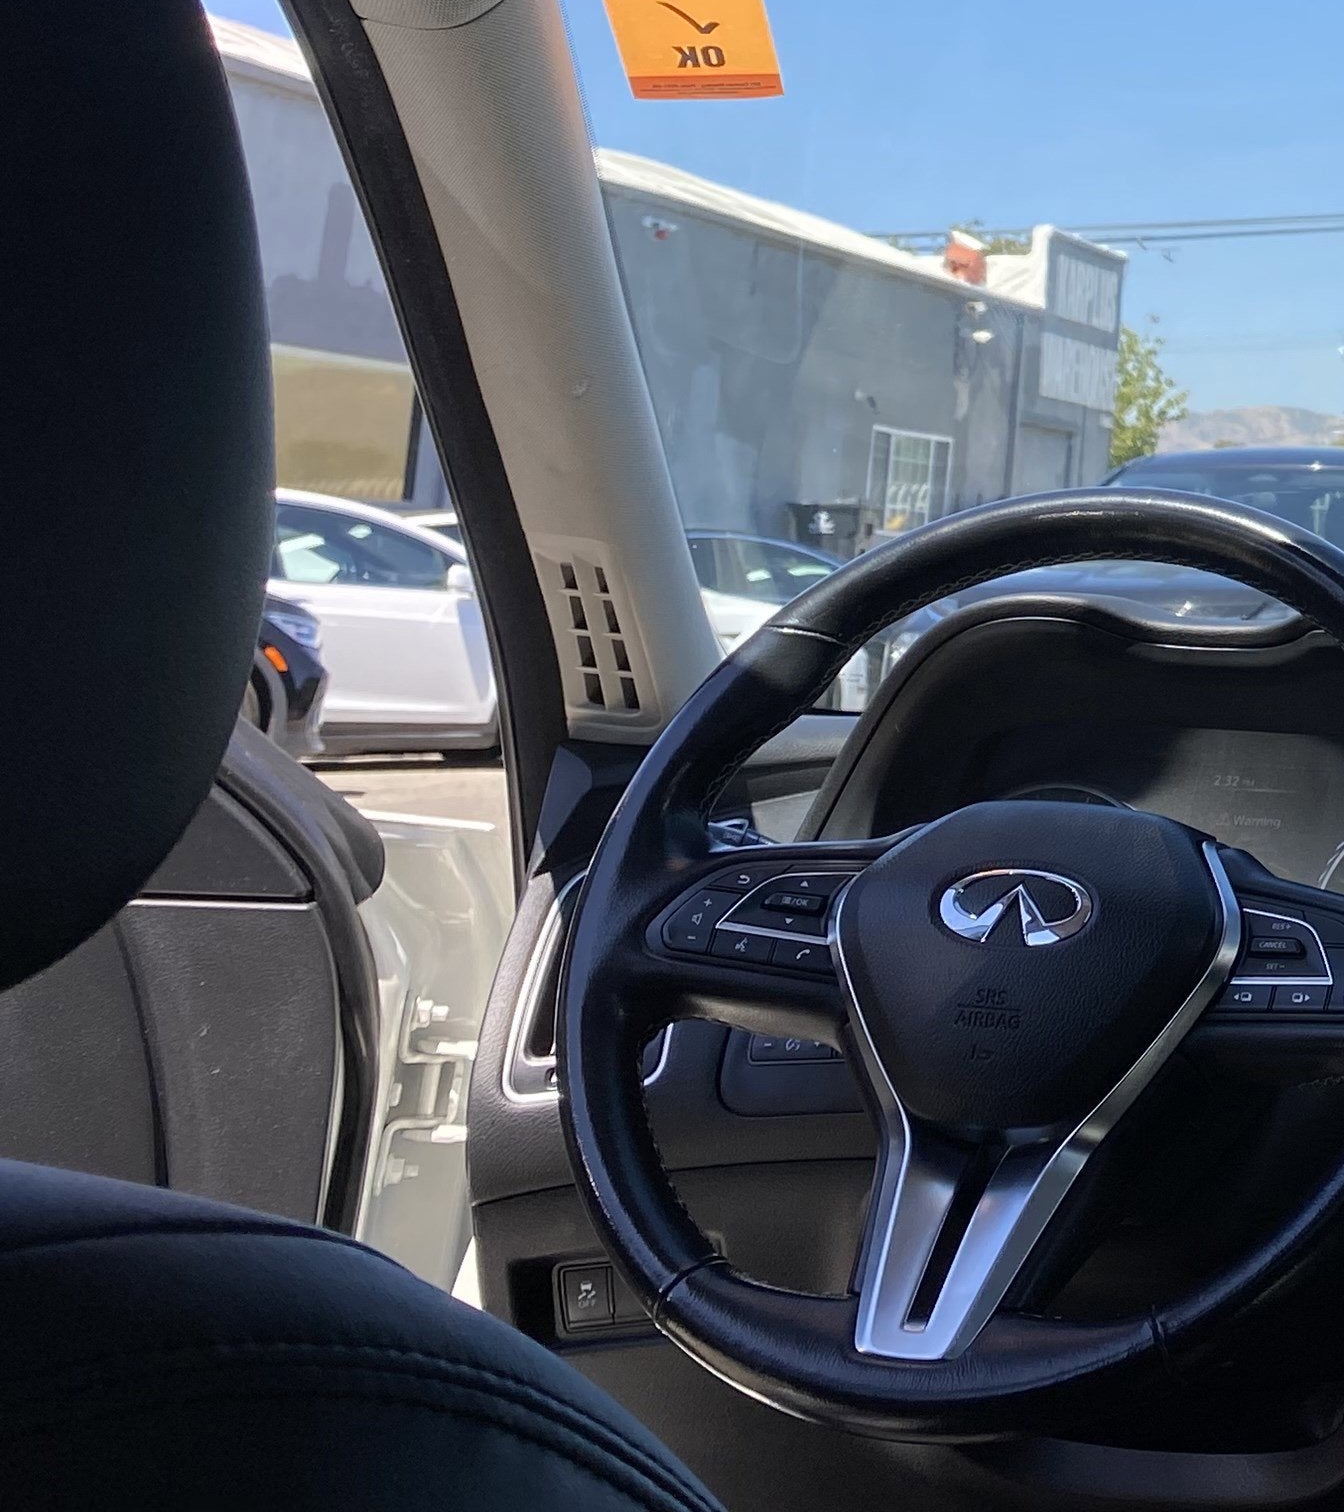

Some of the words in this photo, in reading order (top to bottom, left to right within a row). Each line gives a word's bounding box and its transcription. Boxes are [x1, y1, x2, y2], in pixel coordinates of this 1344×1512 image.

[1233, 815, 1281, 830] Warning
[1259, 941, 1287, 949] CANCEL
[975, 988, 1008, 1005] SRS
[954, 1010, 1021, 1030] AIRBAG
